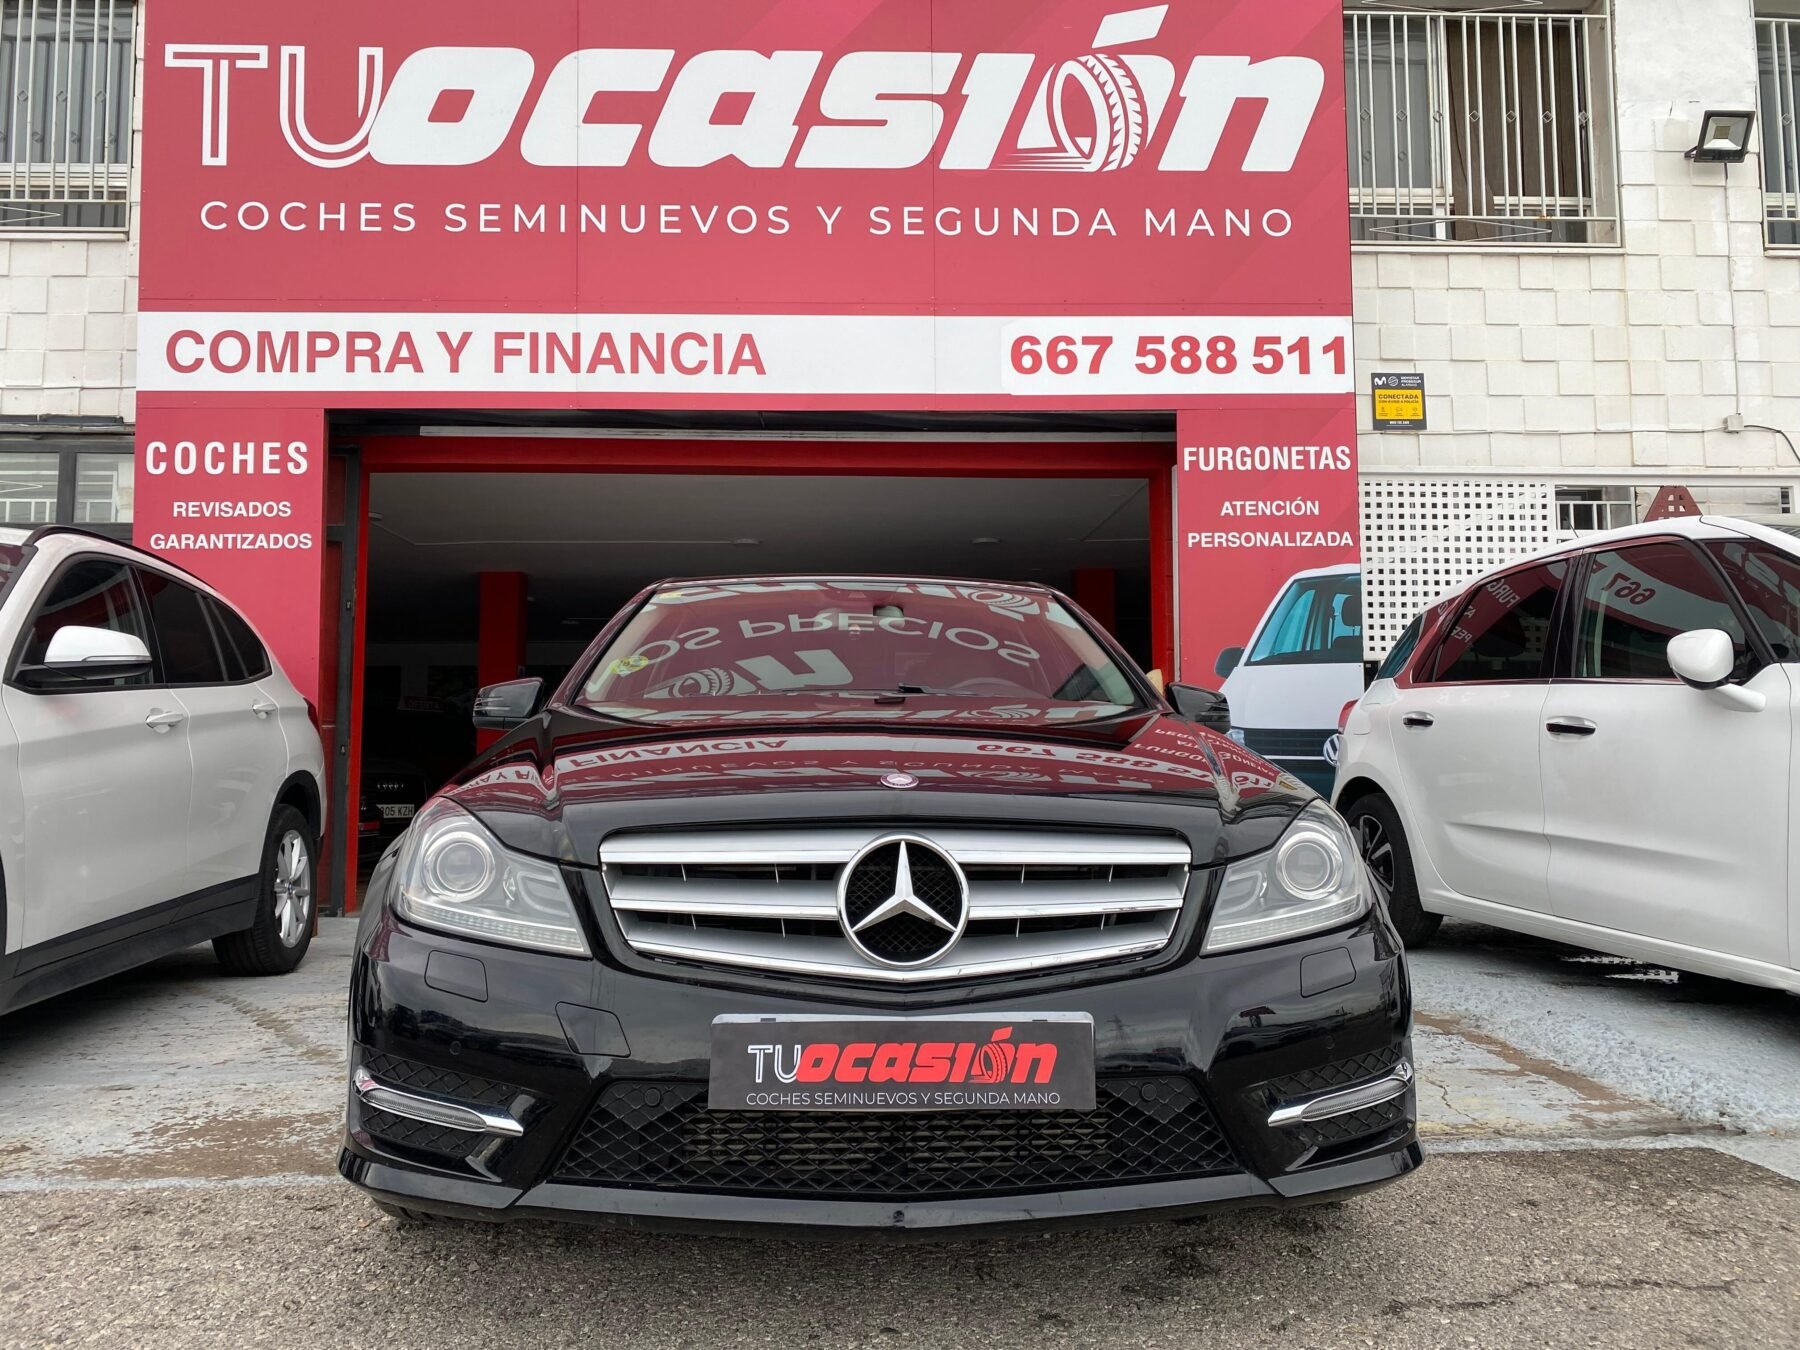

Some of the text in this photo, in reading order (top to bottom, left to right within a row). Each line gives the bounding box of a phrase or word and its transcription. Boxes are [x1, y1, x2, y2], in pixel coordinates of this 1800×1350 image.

[201, 201, 1291, 237] COCHES SEMINUEVOS Y SEGUNDA MANO
[166, 330, 766, 375] COMPRA Y FINANCIA
[1011, 336, 1345, 374] 667 588 511
[146, 441, 308, 475] COCHES
[1184, 446, 1351, 471] FURGONETAS
[173, 501, 291, 517] REVISADOS
[1220, 497, 1319, 516] ATENCIÓN
[150, 533, 312, 549] GARANTIZADOS
[1188, 531, 1353, 547] PERSONALIZADA
[746, 1092, 1061, 1105] COCHES SEMINUEVOS Y SEGUNDA MANO
